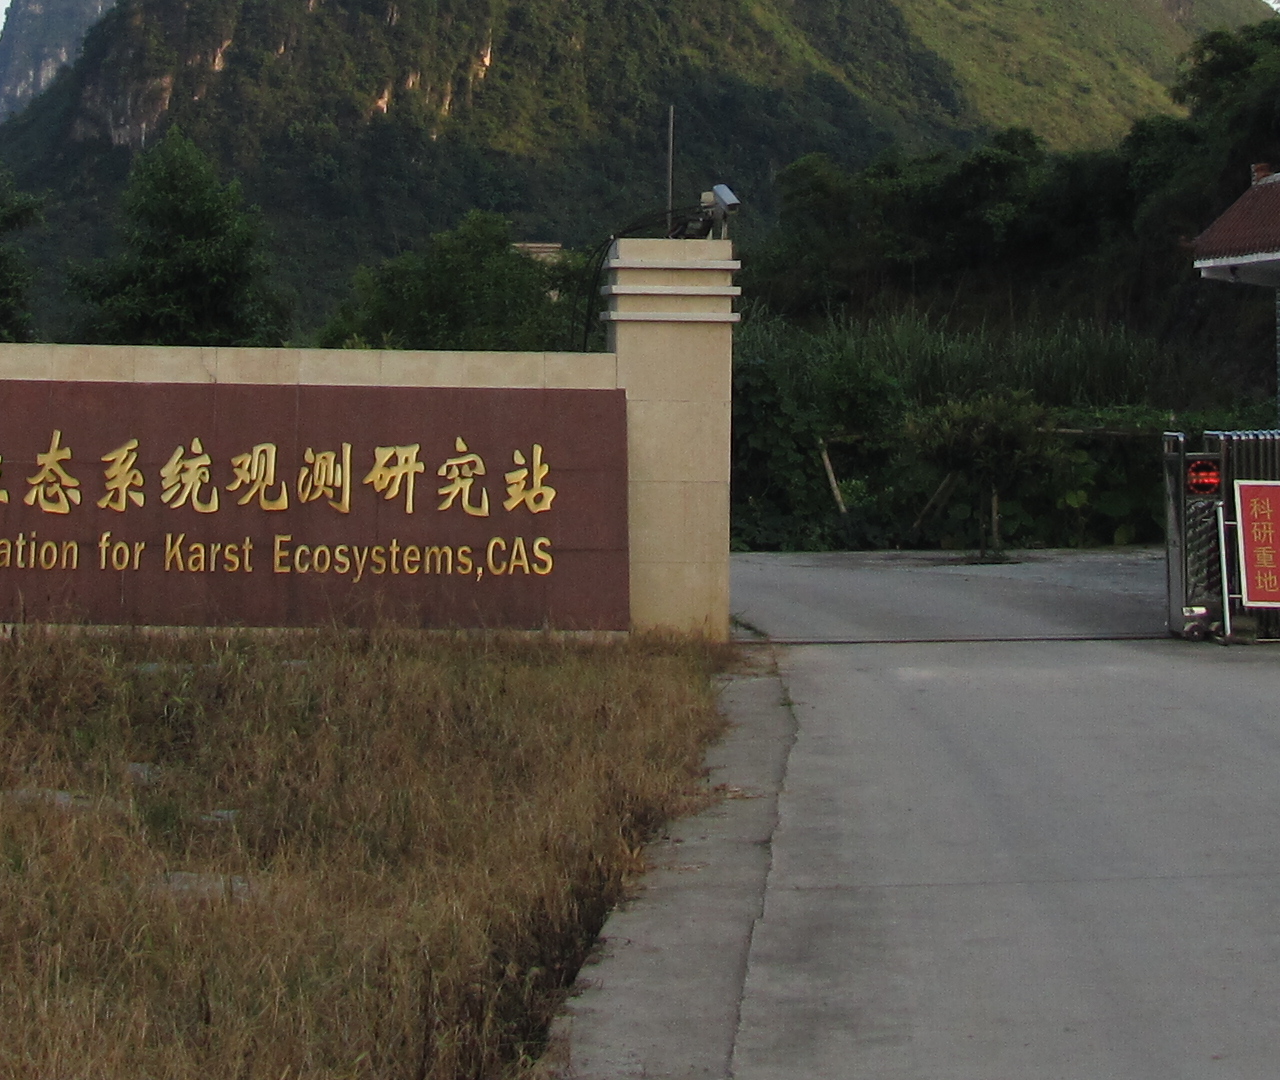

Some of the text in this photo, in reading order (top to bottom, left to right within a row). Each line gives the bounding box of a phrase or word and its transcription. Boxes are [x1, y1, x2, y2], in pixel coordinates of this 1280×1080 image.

[98, 530, 146, 571] for
[163, 532, 254, 573] Karst
[1249, 497, 1280, 593] 科研重地
